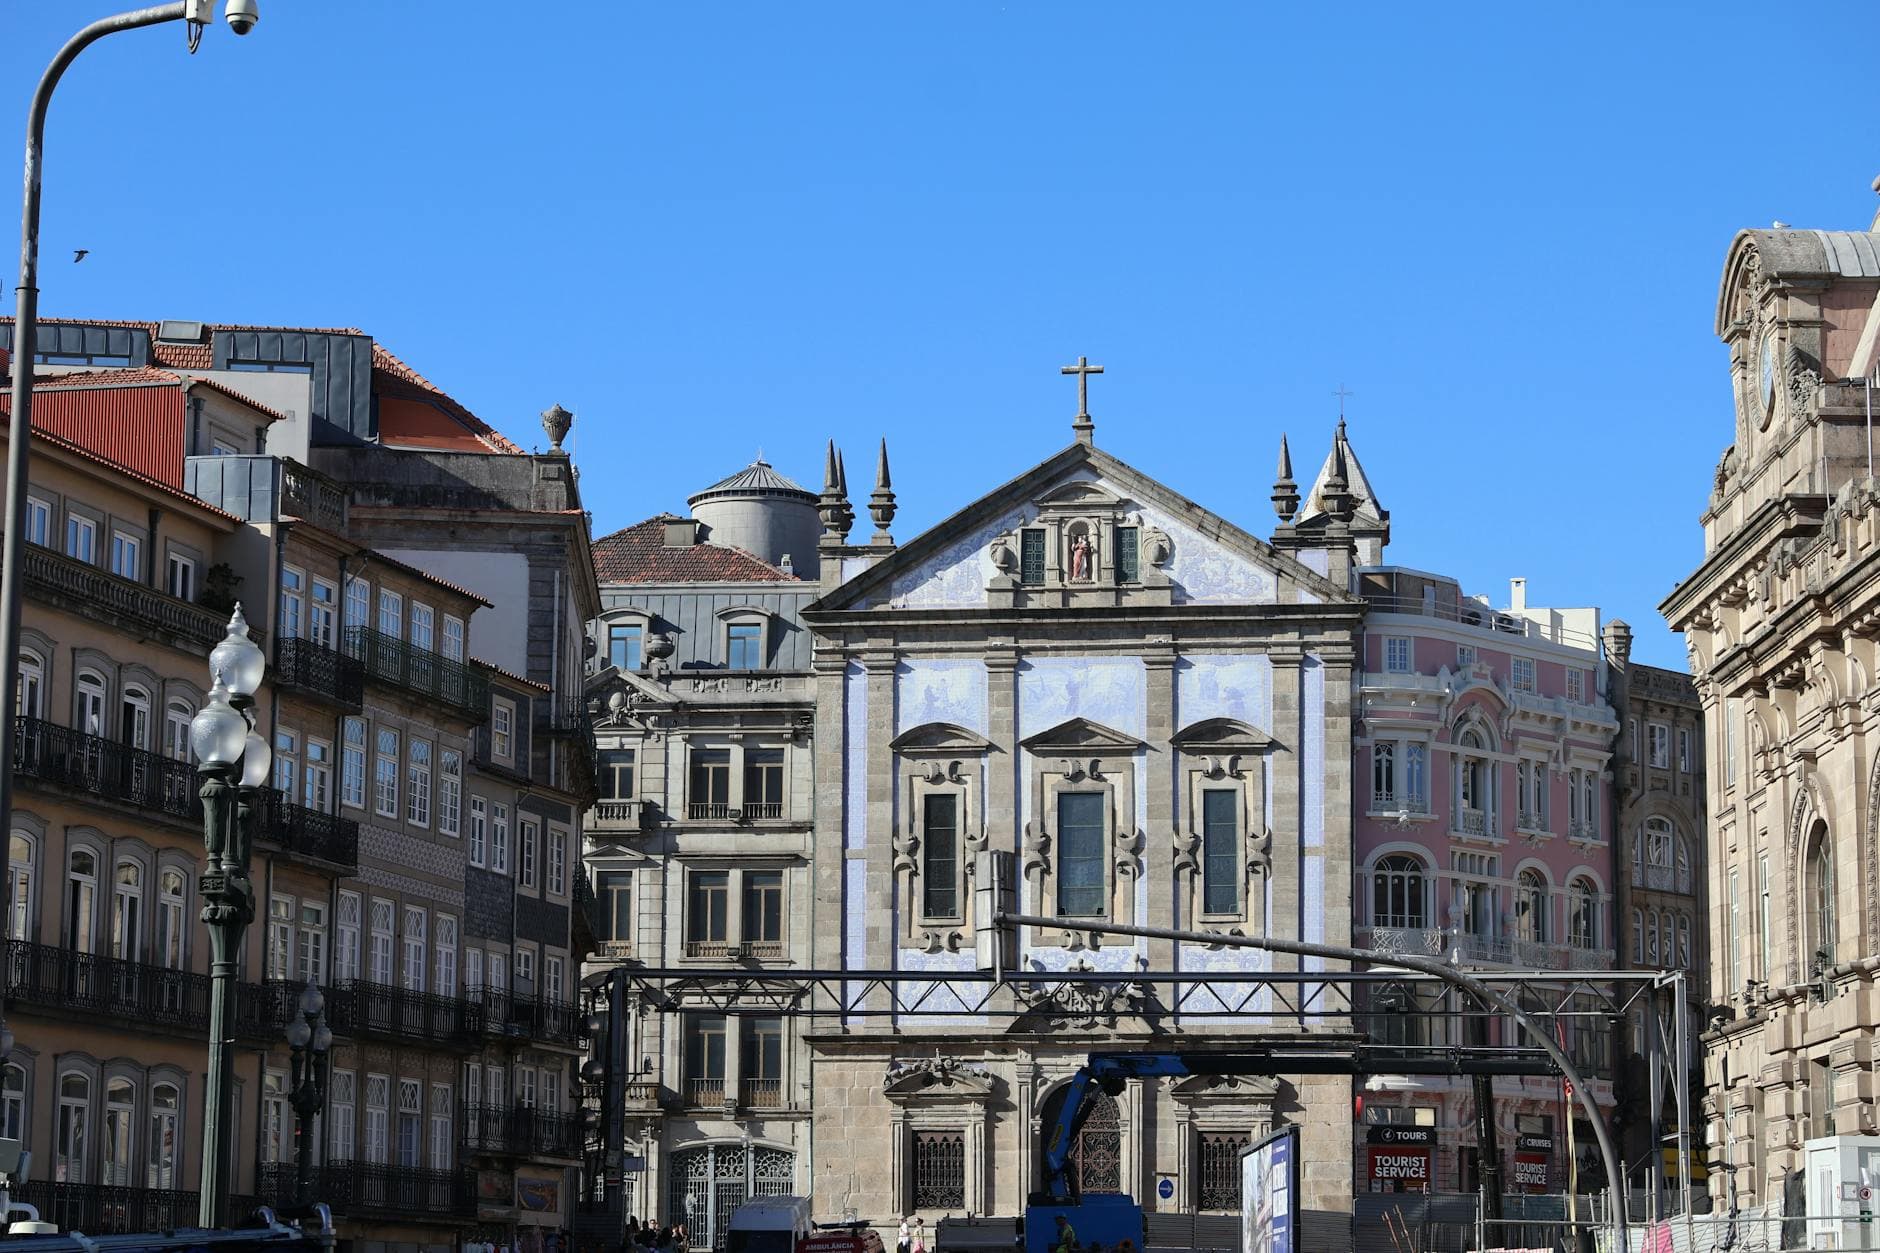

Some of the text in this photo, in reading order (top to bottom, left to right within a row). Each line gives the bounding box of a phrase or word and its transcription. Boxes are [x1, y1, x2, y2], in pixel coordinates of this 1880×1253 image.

[1396, 1131, 1427, 1140] TOURS
[1526, 1138, 1552, 1148] CRUISES
[1375, 1155, 1427, 1167] TOURIST
[1375, 1166, 1426, 1178] SERVICE
[1515, 1162, 1547, 1174] TOURIST
[1515, 1172, 1547, 1185] SERVICE
